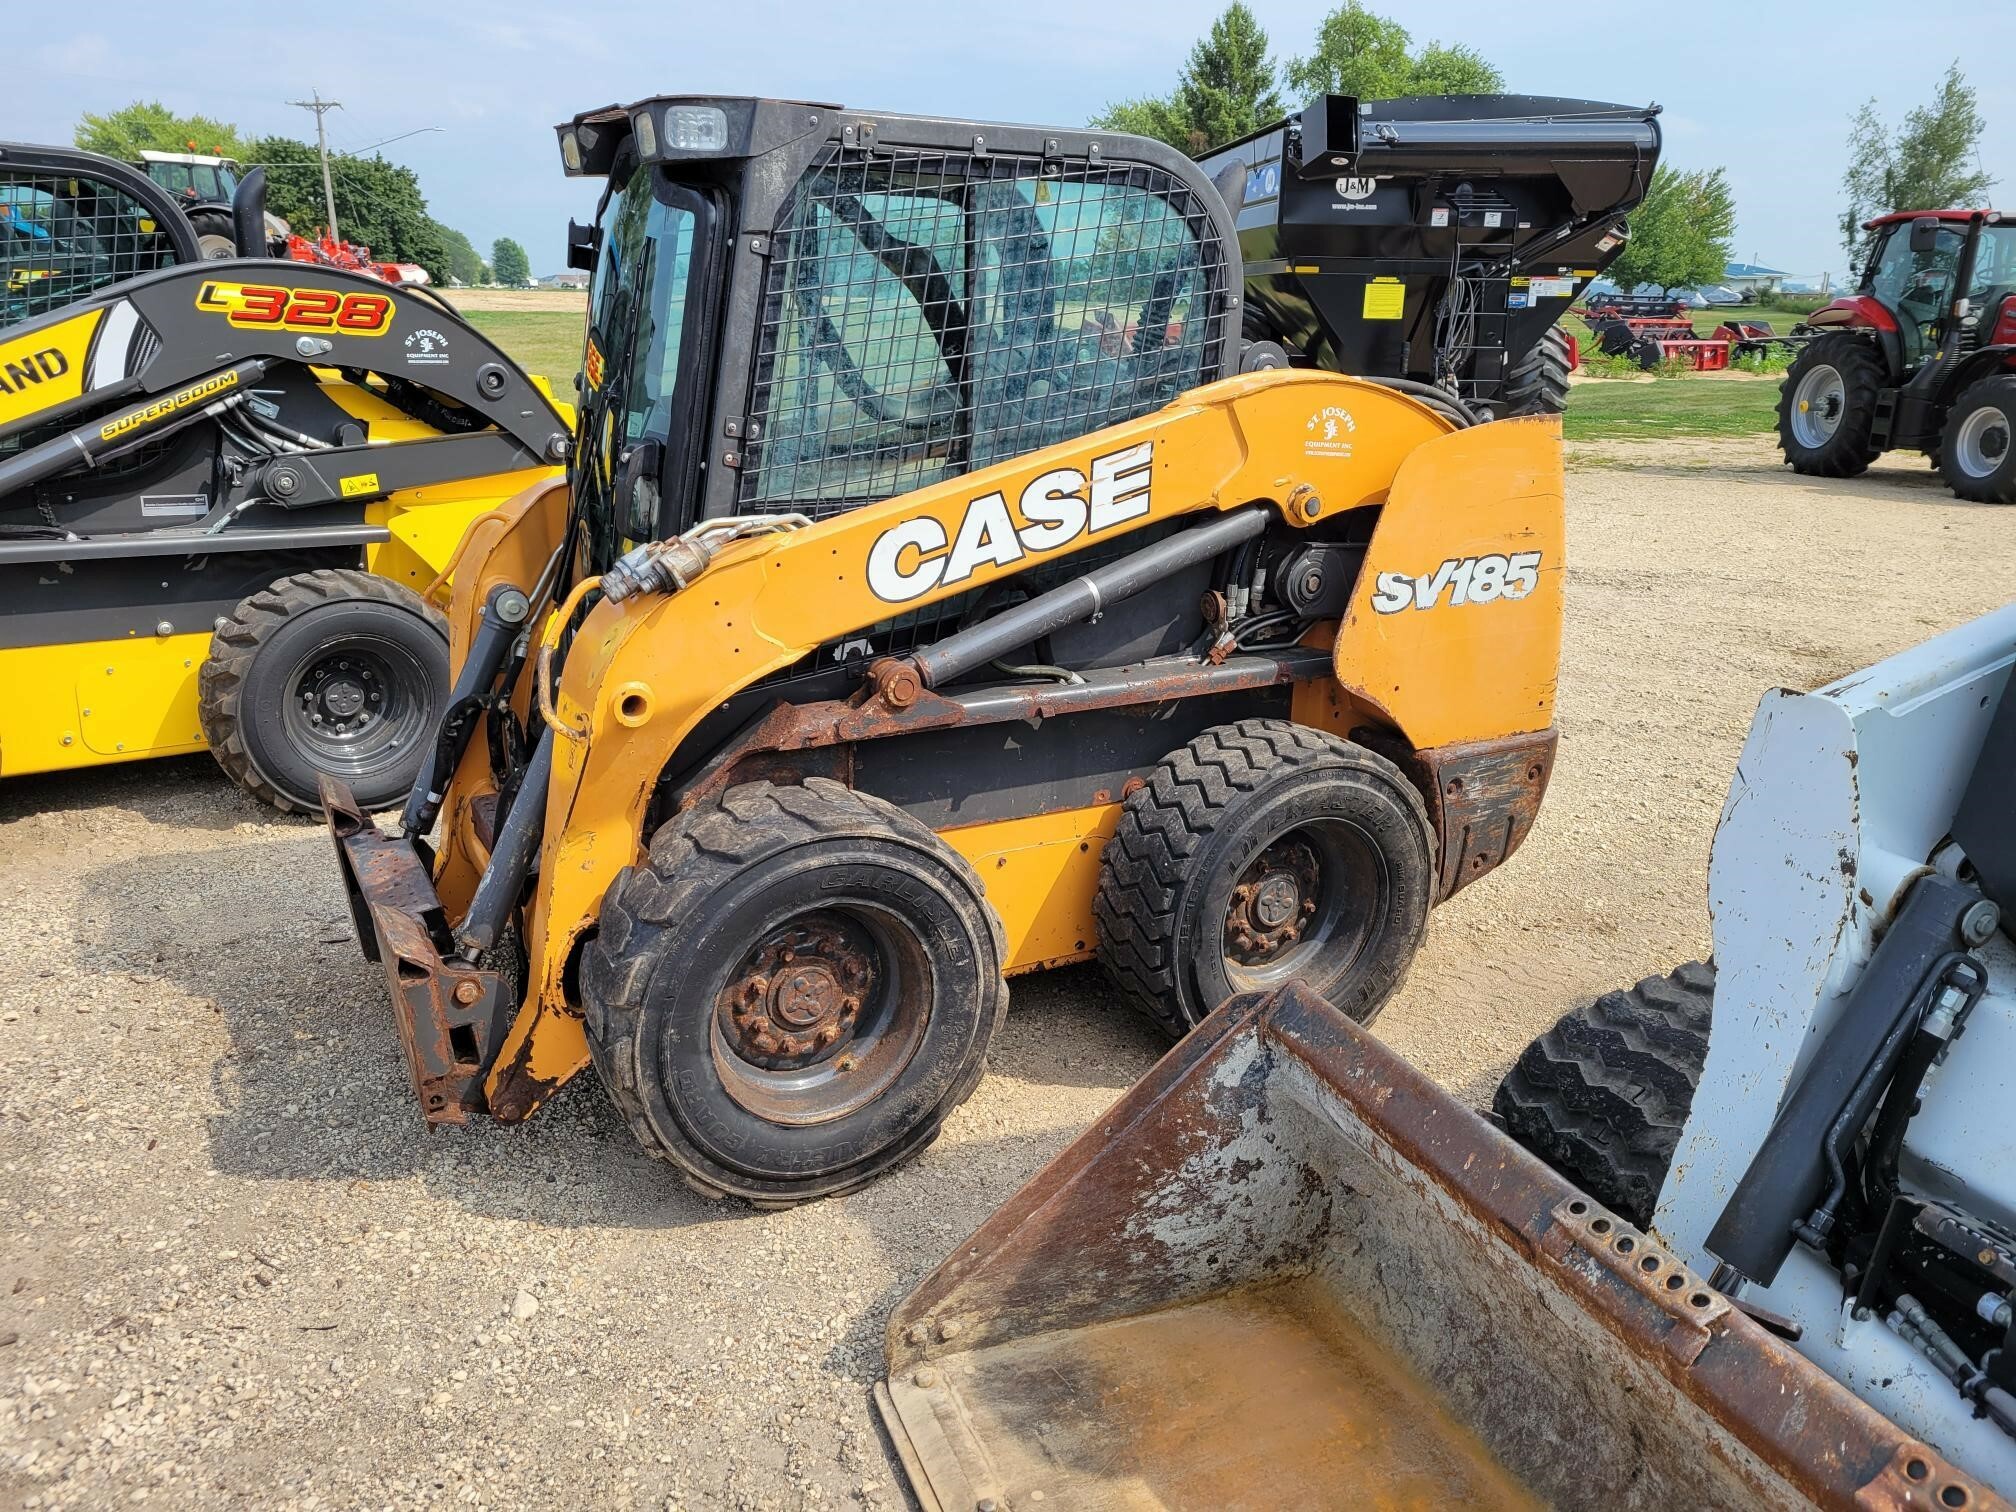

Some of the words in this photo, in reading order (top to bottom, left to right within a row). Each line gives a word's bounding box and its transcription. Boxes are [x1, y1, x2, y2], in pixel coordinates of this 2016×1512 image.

[1339, 177, 1369, 194] J&M
[198, 282, 392, 332] L328
[415, 329, 449, 347] JOSEPH
[102, 398, 175, 438] SUPER
[177, 372, 237, 406] BOOM
[1322, 407, 1356, 432] JOSEPH
[866, 440, 1154, 604] CASE
[1370, 550, 1543, 615] SV185
[820, 866, 969, 963] CARLISLE
